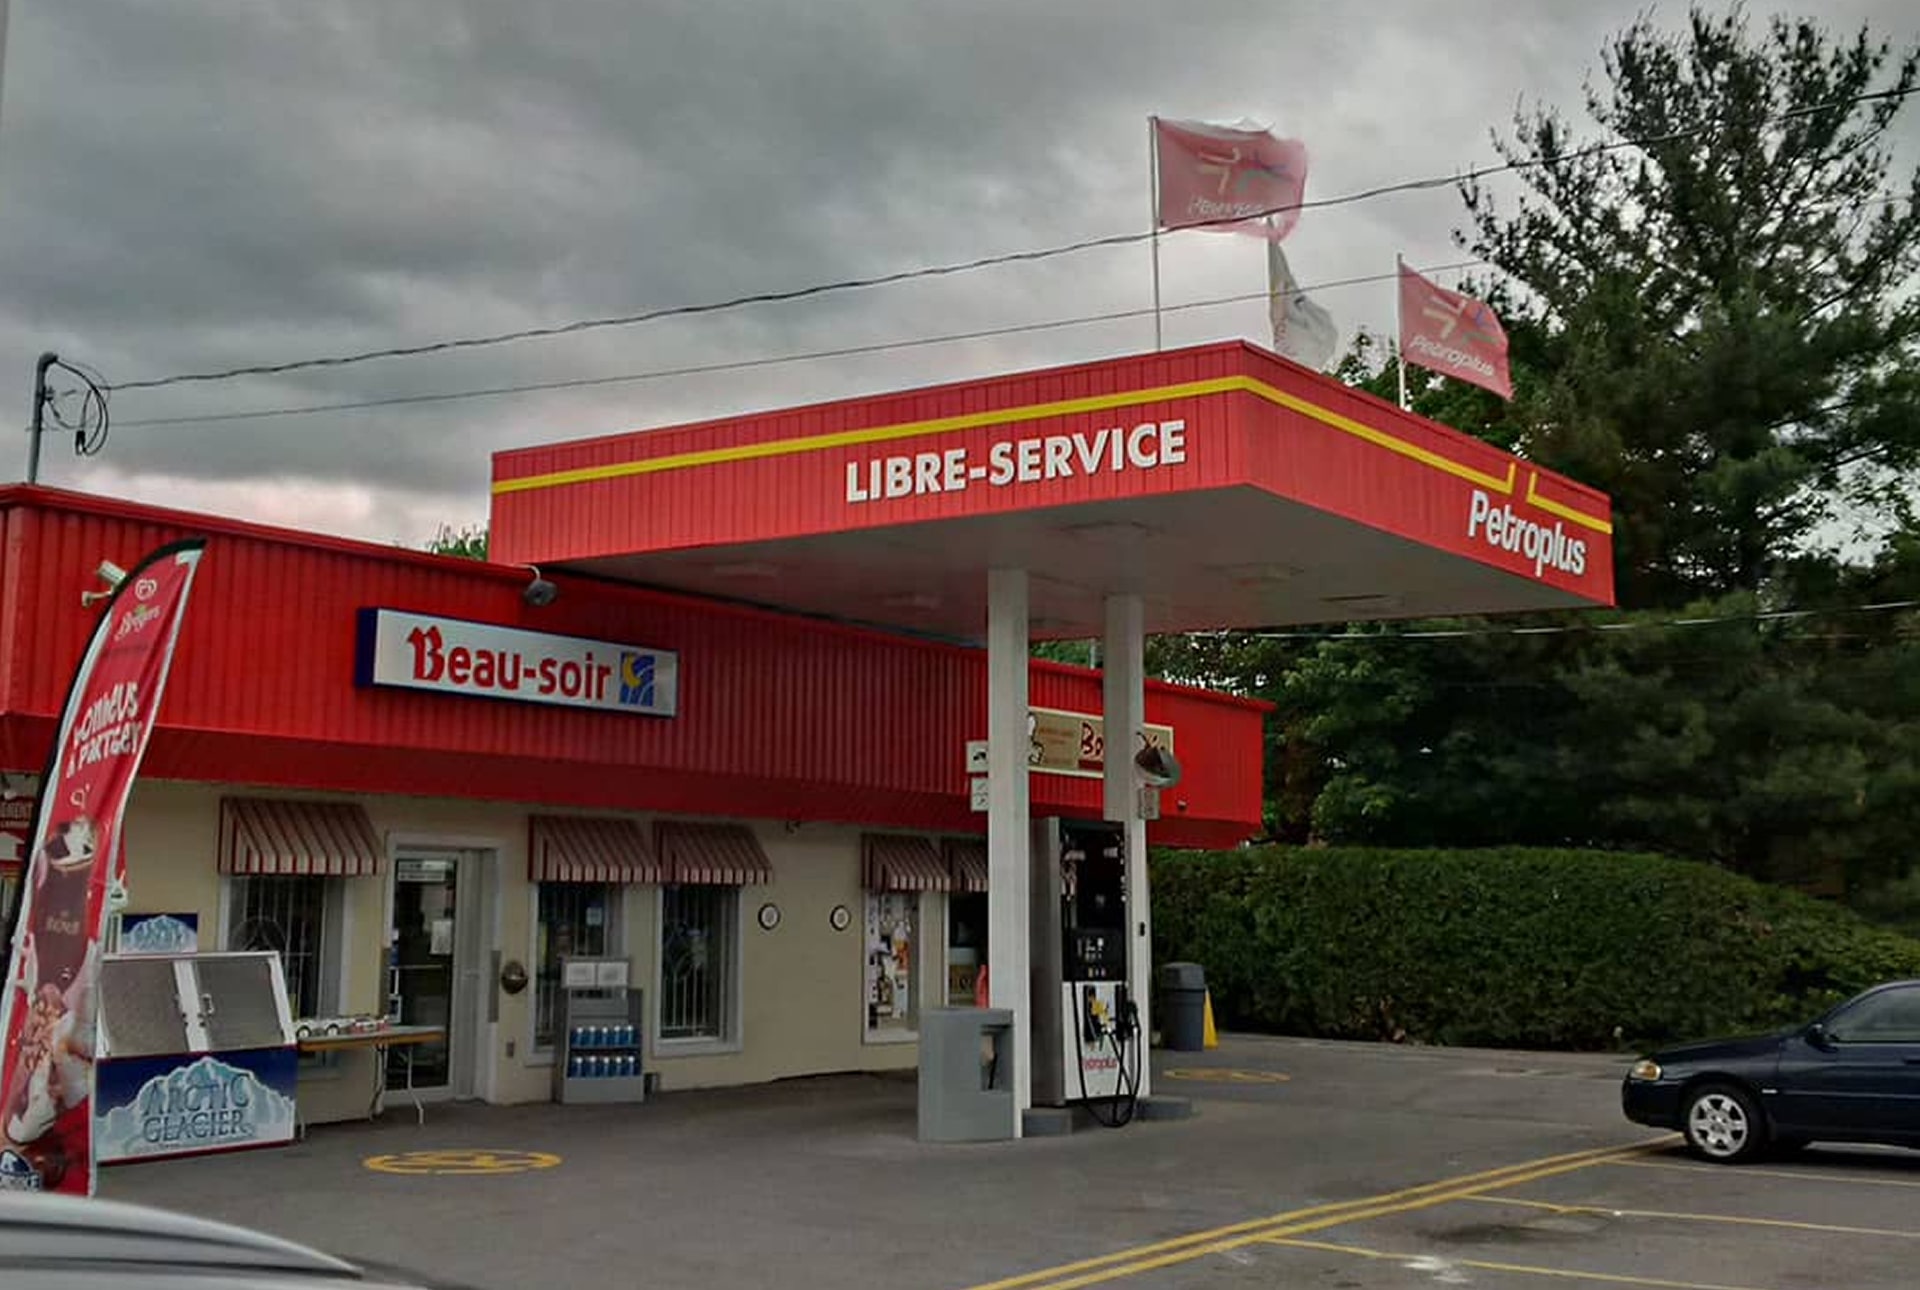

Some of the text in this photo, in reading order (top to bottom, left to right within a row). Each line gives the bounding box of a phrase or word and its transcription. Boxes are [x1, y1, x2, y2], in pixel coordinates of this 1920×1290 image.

[846, 419, 1187, 503] LIBRE-SERVICE
[1467, 489, 1586, 578] Petroplus
[407, 625, 612, 699] Beau-soir
[142, 1108, 250, 1143] GLACIER
[143, 1073, 251, 1117] ARCTIC
